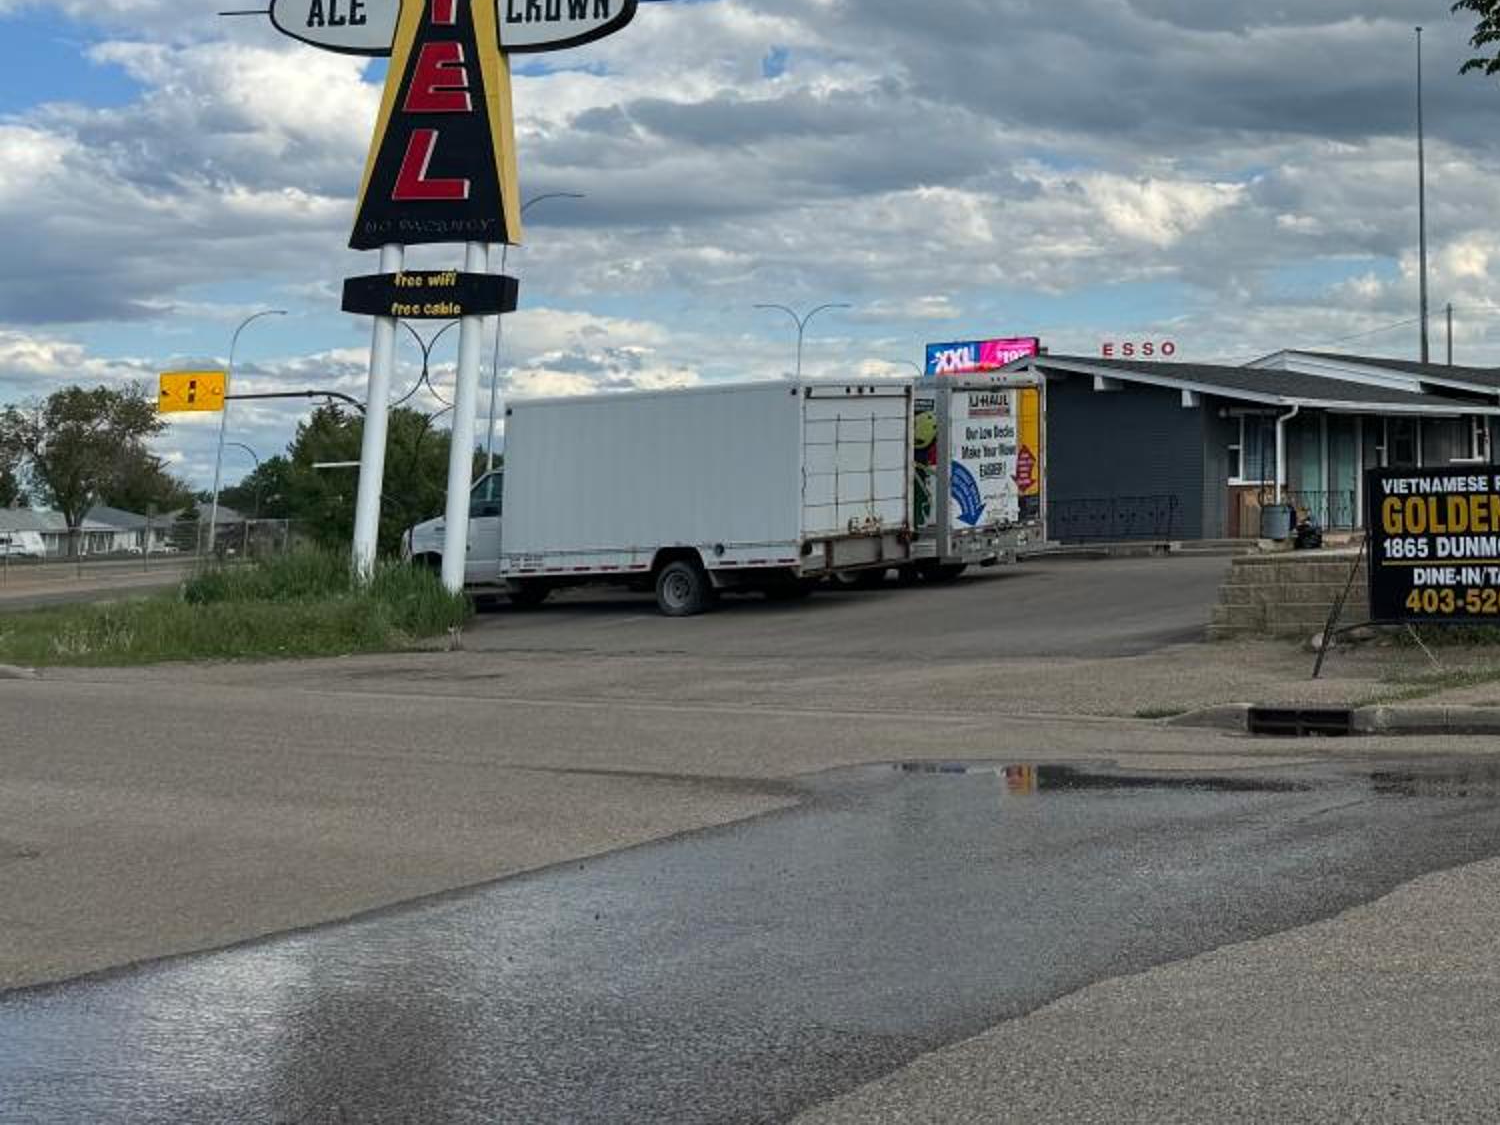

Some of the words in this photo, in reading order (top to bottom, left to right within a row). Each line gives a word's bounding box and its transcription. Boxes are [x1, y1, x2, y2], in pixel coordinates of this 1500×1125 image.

[394, 272, 422, 287] free
[391, 303, 421, 316] free
[423, 302, 461, 316] cable
[1103, 342, 1175, 356] ESSO
[1382, 476, 1488, 494] VIETNAMESE
[1383, 538, 1429, 558] 1865
